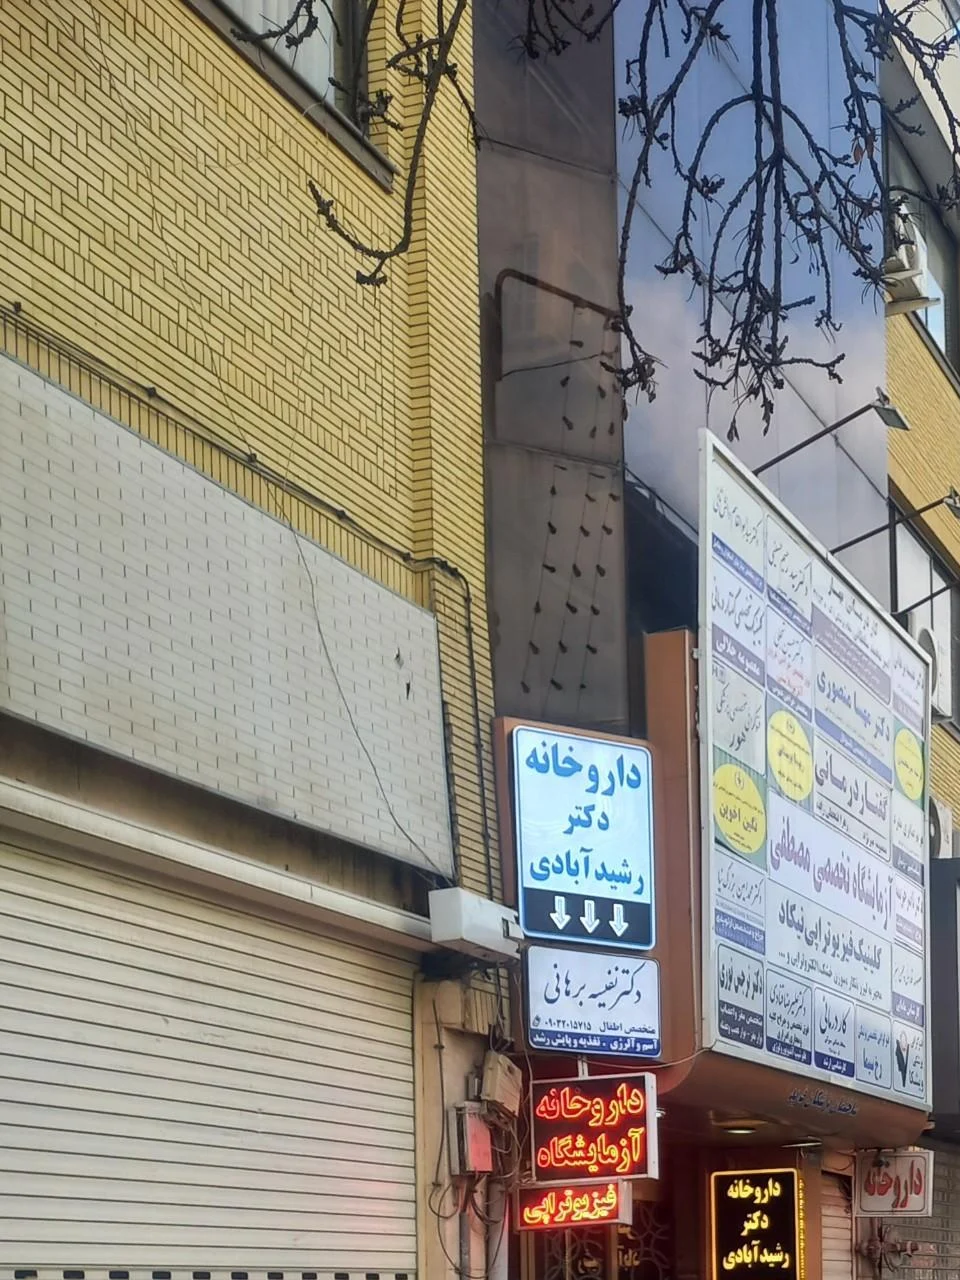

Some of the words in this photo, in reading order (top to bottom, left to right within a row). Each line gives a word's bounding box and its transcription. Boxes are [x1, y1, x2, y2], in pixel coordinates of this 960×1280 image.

[816, 671, 852, 709] منصوری
[873, 716, 890, 742] دکتر
[525, 741, 642, 796] داروخانه
[563, 805, 610, 834] دکتر
[770, 817, 811, 872] مصطفی
[812, 852, 850, 894] تخصصی
[852, 863, 893, 930] آزمایشگاه
[804, 918, 854, 962] فیزیوتراپی
[853, 938, 882, 974] کلینیک
[544, 963, 586, 1007] برهانی
[588, 966, 618, 1009] نفیسه
[608, 962, 647, 1011] دکتر
[751, 970, 763, 1001] دکتر
[532, 1031, 550, 1043] رشد
[599, 1021, 623, 1033] اطفال
[609, 1036, 635, 1051] آلرژی
[624, 1022, 657, 1034] متخصص
[536, 1083, 644, 1127] داروخانه
[537, 1127, 645, 1173] آزمایشگاه
[523, 1183, 617, 1225] فیزیوتراپی
[726, 1178, 781, 1204] داروخانه
[865, 1160, 923, 1208] داروخانه
[741, 1211, 769, 1236] دکتر
